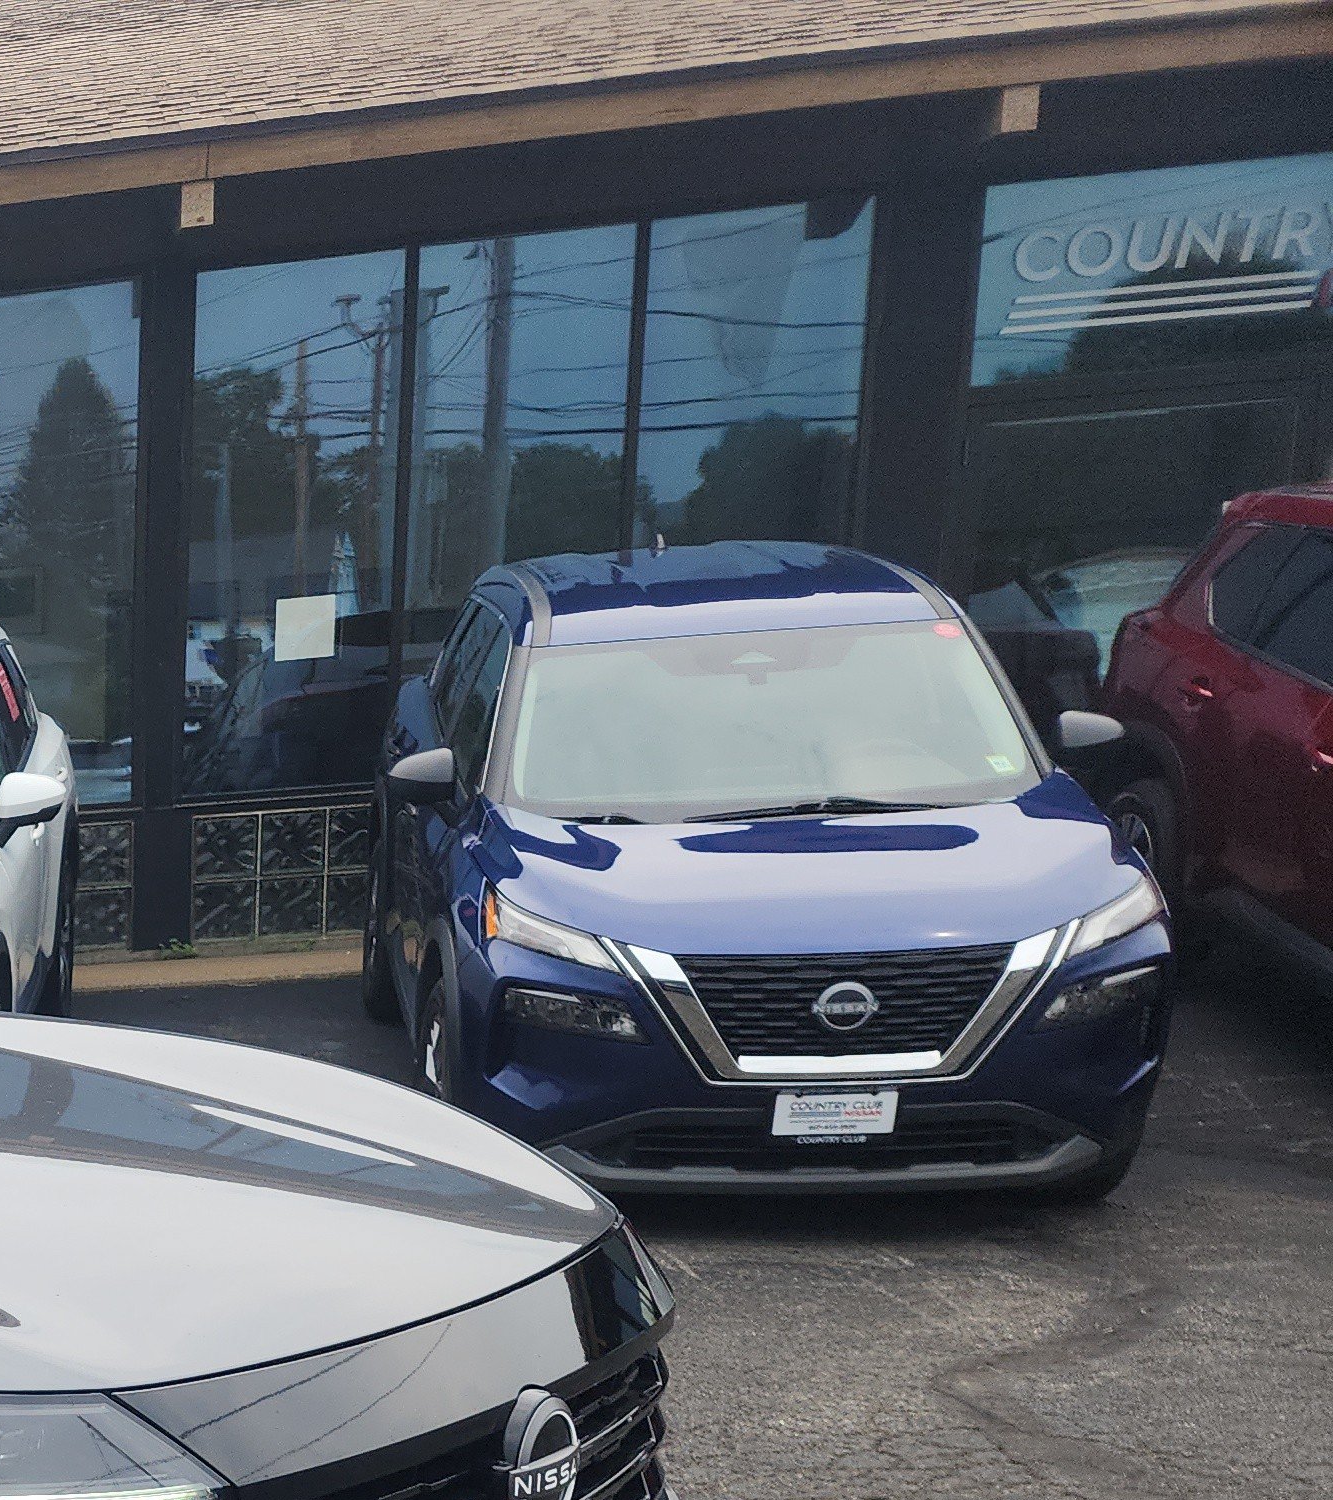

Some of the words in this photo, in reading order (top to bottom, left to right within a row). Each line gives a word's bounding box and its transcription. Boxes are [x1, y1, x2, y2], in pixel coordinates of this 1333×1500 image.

[1014, 203, 1333, 283] COUNTR
[789, 1101, 850, 1111] COUNTRY
[852, 1100, 884, 1110] CLUB
[796, 1136, 841, 1145] COUNTRY
[514, 1458, 578, 1497] NISSA
